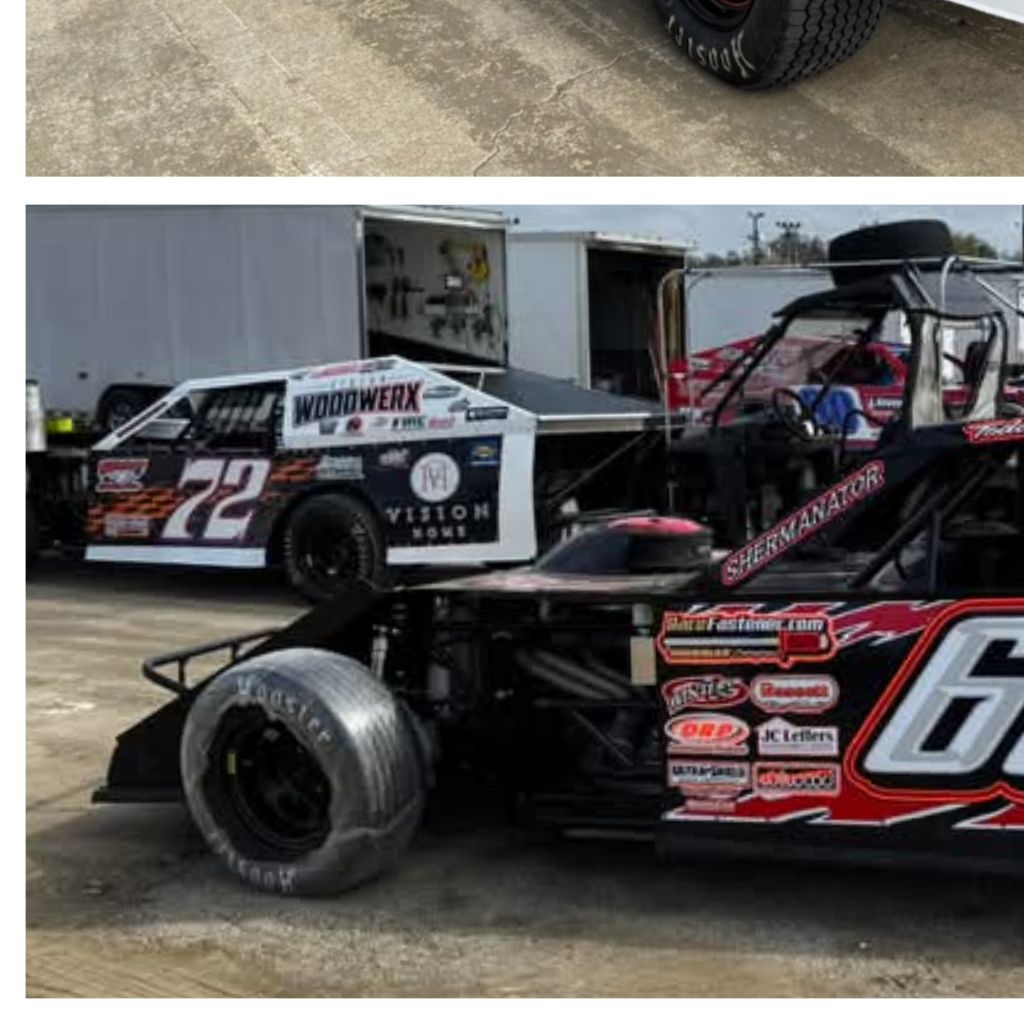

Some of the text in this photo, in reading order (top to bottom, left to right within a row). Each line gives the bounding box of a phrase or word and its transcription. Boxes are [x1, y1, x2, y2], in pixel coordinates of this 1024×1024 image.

[293, 379, 425, 428] WOODWERX
[161, 457, 271, 542] 72
[726, 465, 881, 581] SHERMANATOR
